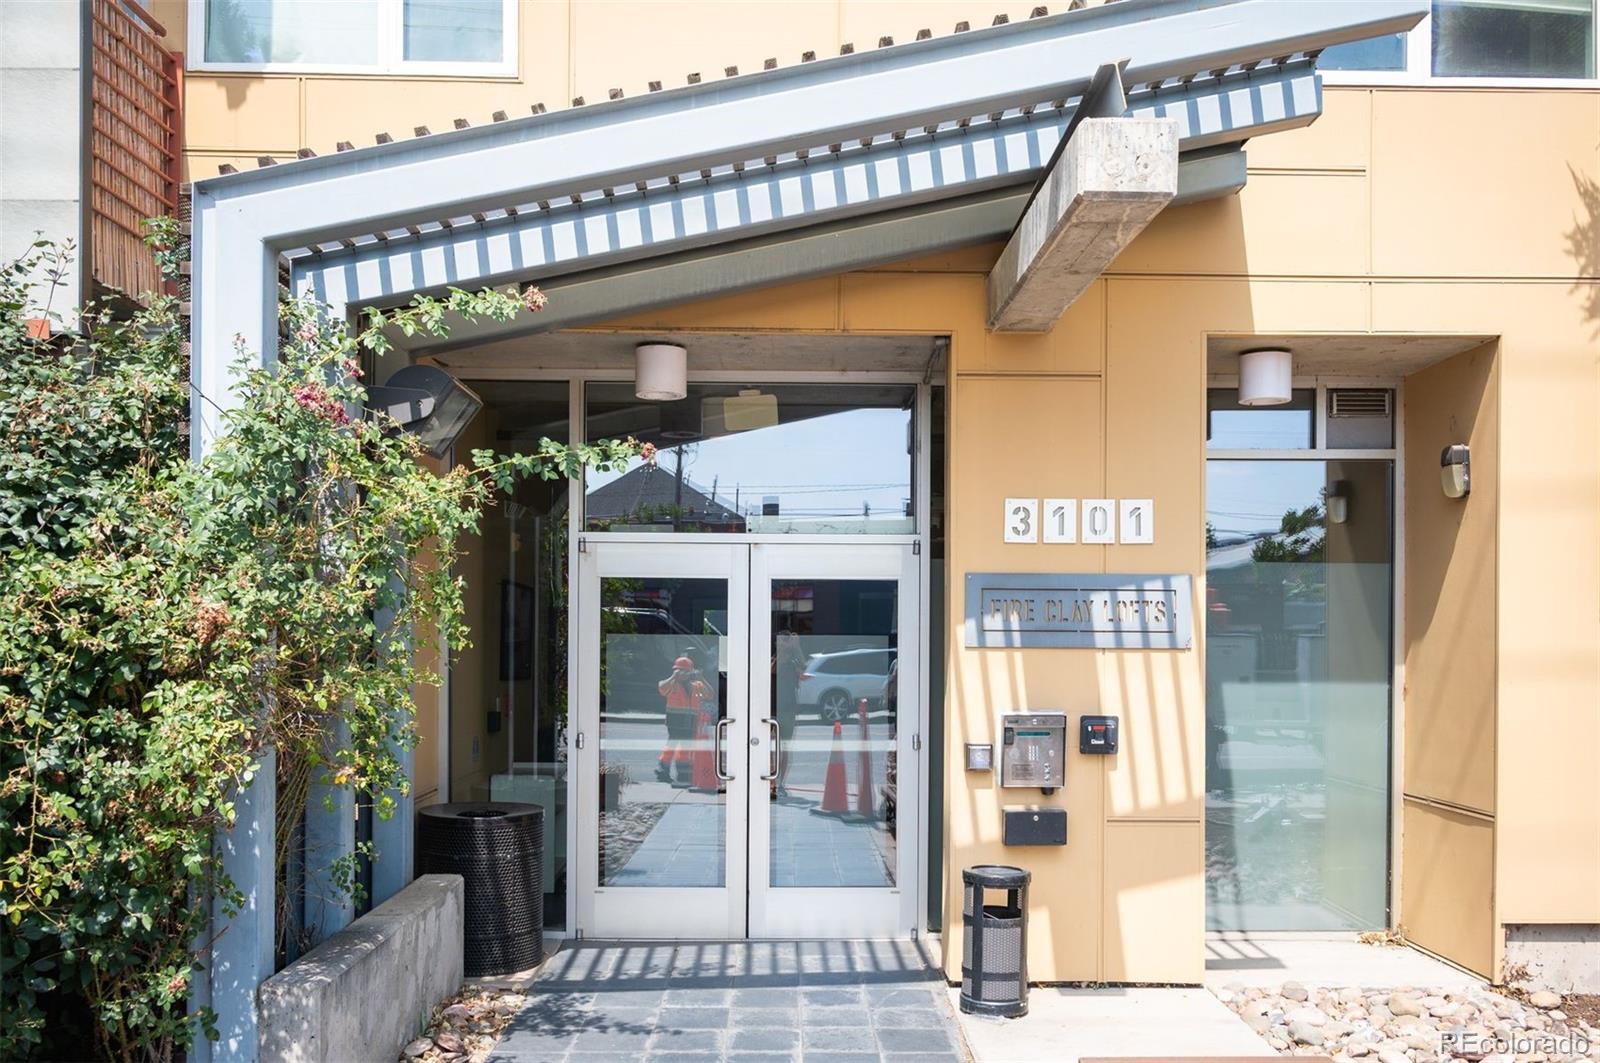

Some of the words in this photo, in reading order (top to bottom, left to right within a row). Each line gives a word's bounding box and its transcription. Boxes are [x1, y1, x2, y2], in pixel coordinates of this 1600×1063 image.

[1011, 505, 1142, 537] 3101
[990, 599, 1035, 622] FIRE
[1045, 599, 1094, 623] CLAY
[1103, 600, 1167, 623] LOFTS
